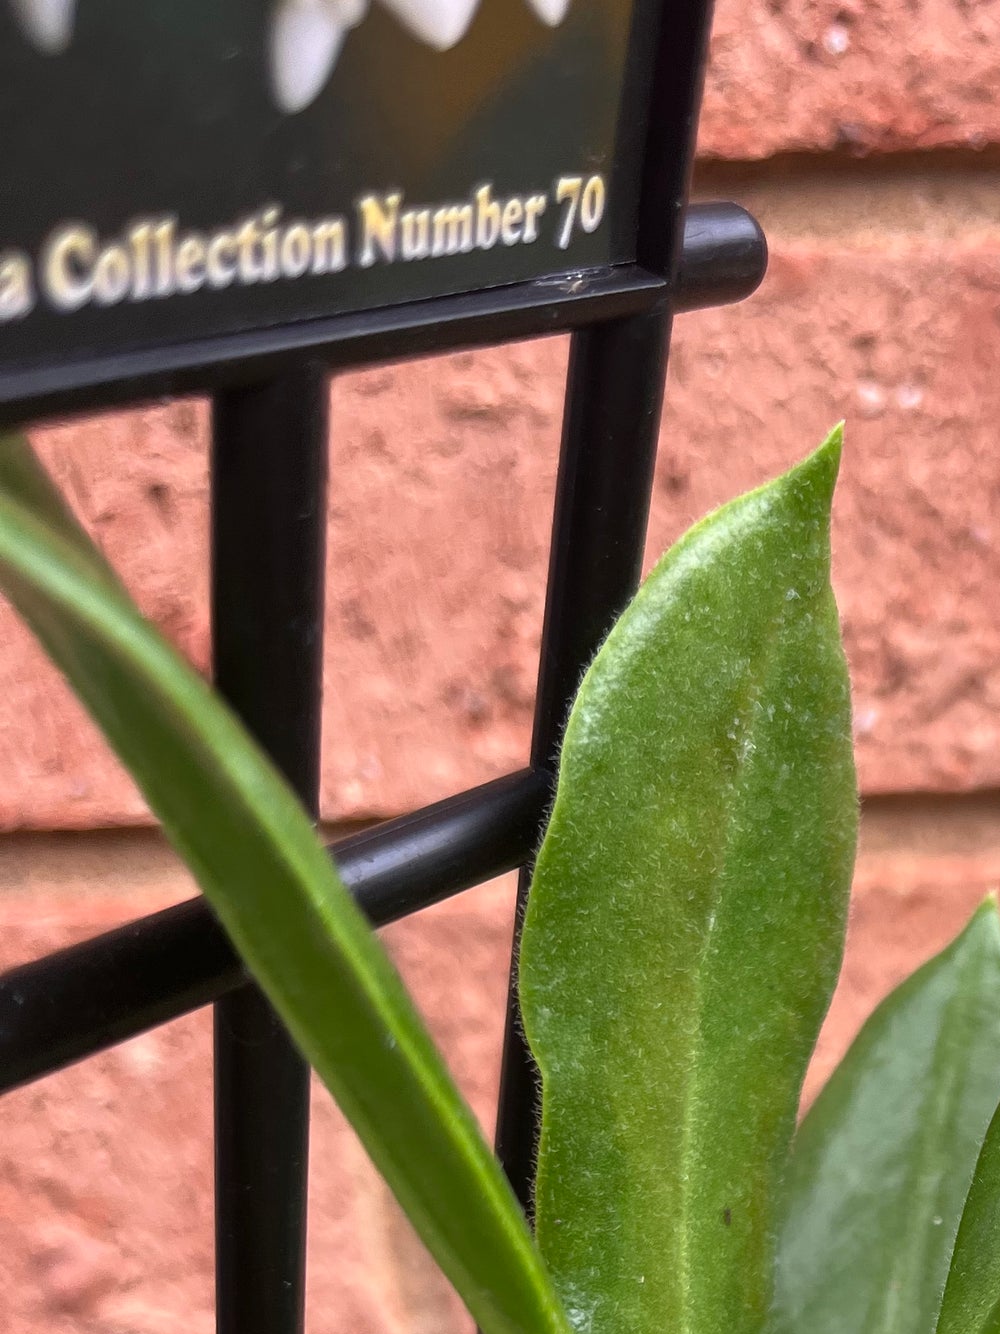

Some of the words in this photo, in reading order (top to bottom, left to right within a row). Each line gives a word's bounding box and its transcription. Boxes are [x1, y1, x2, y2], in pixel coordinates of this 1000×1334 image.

[43, 206, 346, 310] Collection
[357, 182, 546, 266] Number
[556, 174, 605, 248] 70
